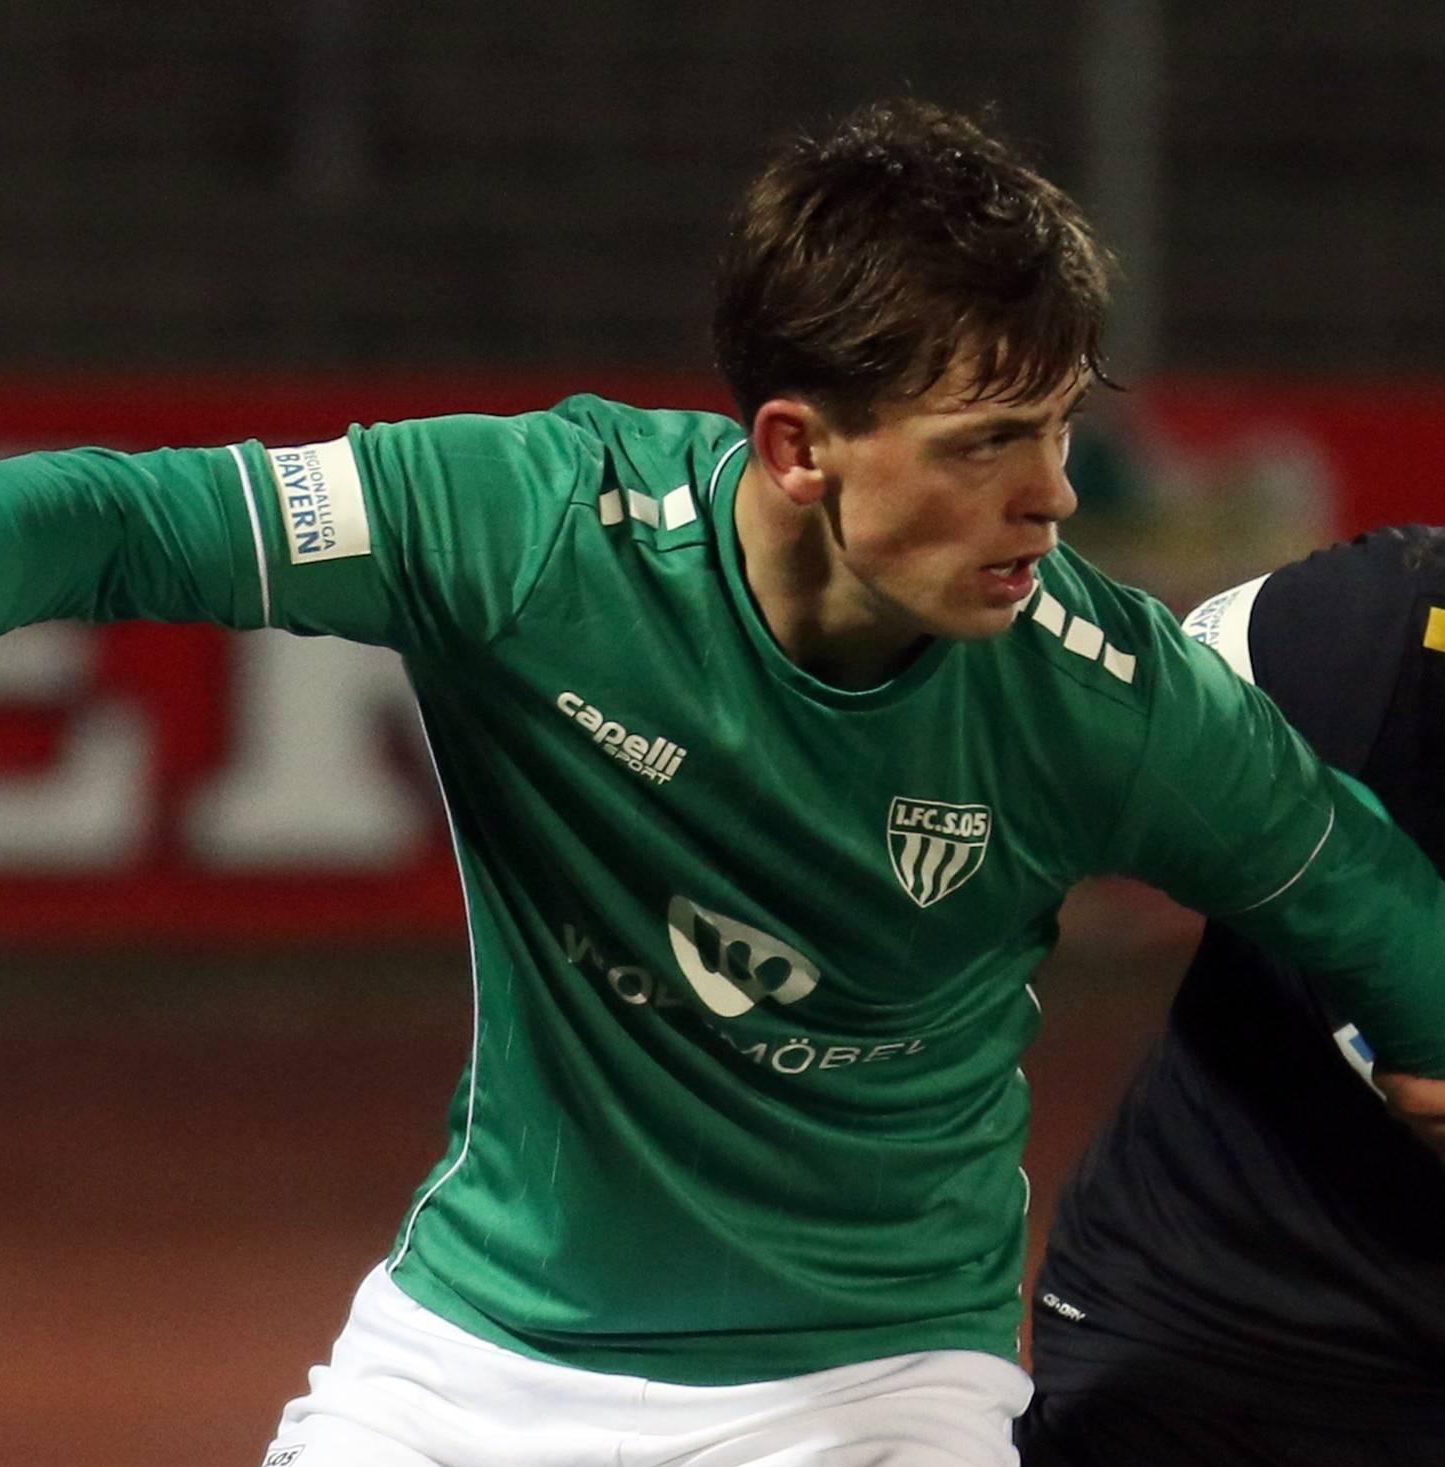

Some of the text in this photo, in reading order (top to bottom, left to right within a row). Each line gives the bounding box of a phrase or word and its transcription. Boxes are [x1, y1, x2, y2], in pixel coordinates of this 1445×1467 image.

[275, 453, 323, 555] BAYERN
[304, 449, 336, 550] REGIONALLIGA
[556, 691, 688, 777] capelli
